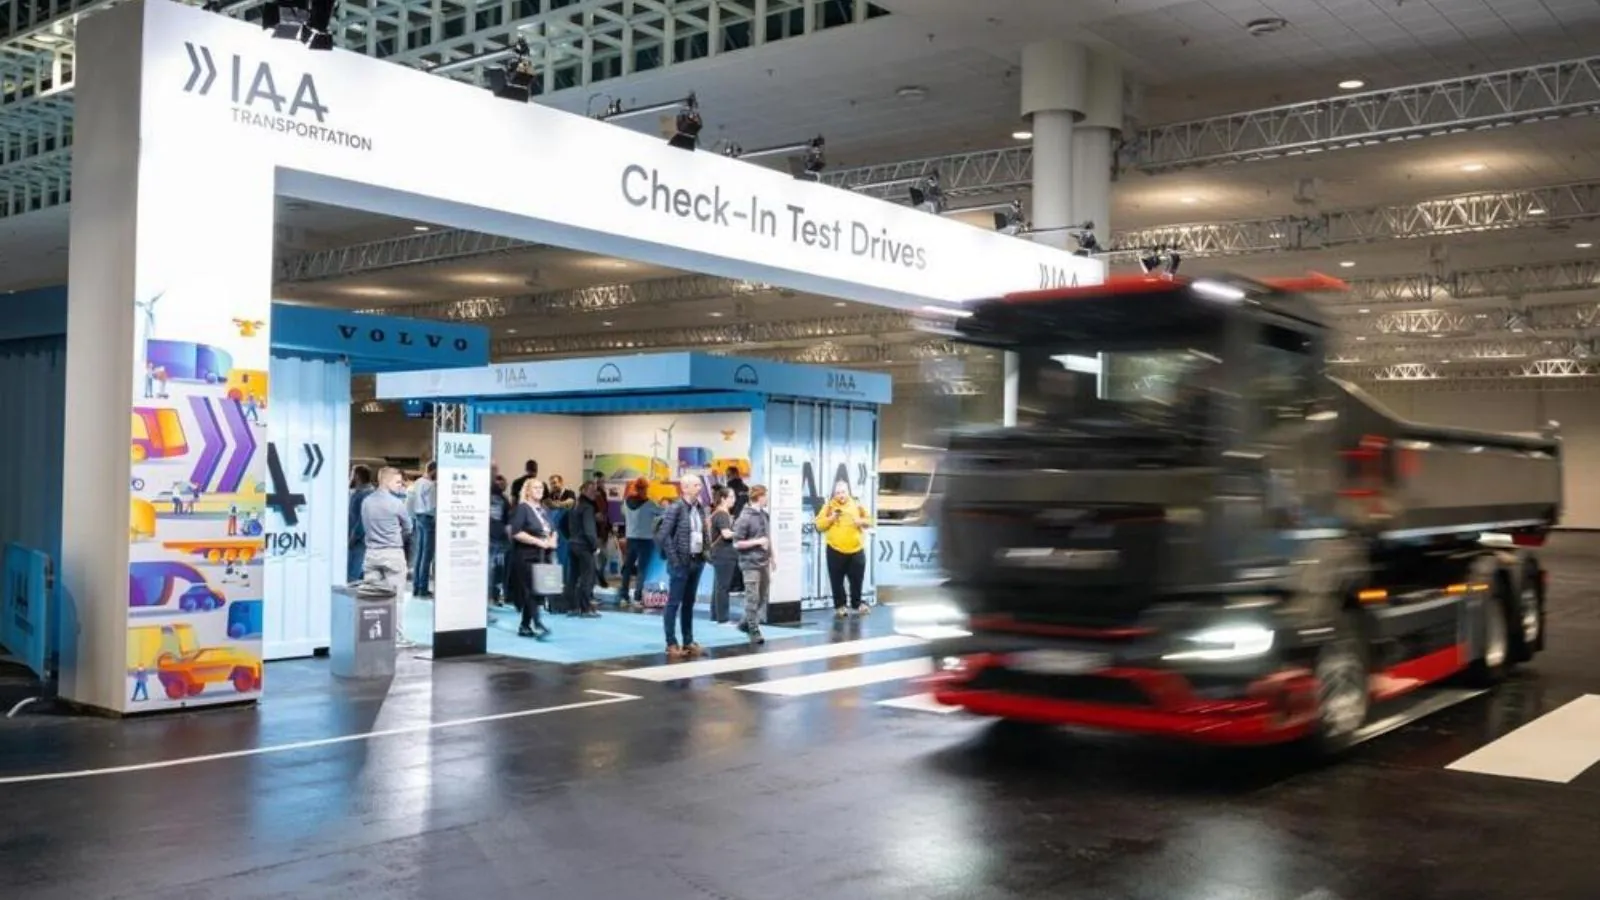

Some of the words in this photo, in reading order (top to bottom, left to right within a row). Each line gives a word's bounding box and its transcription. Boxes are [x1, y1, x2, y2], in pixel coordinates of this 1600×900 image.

[231, 54, 329, 123] IAA
[231, 107, 372, 151] TRANSPORTATION
[621, 164, 776, 238] Check-In
[787, 204, 842, 252] Test
[851, 222, 927, 270] Drives
[337, 324, 468, 352] VOLVO
[453, 442, 475, 454] IAA
